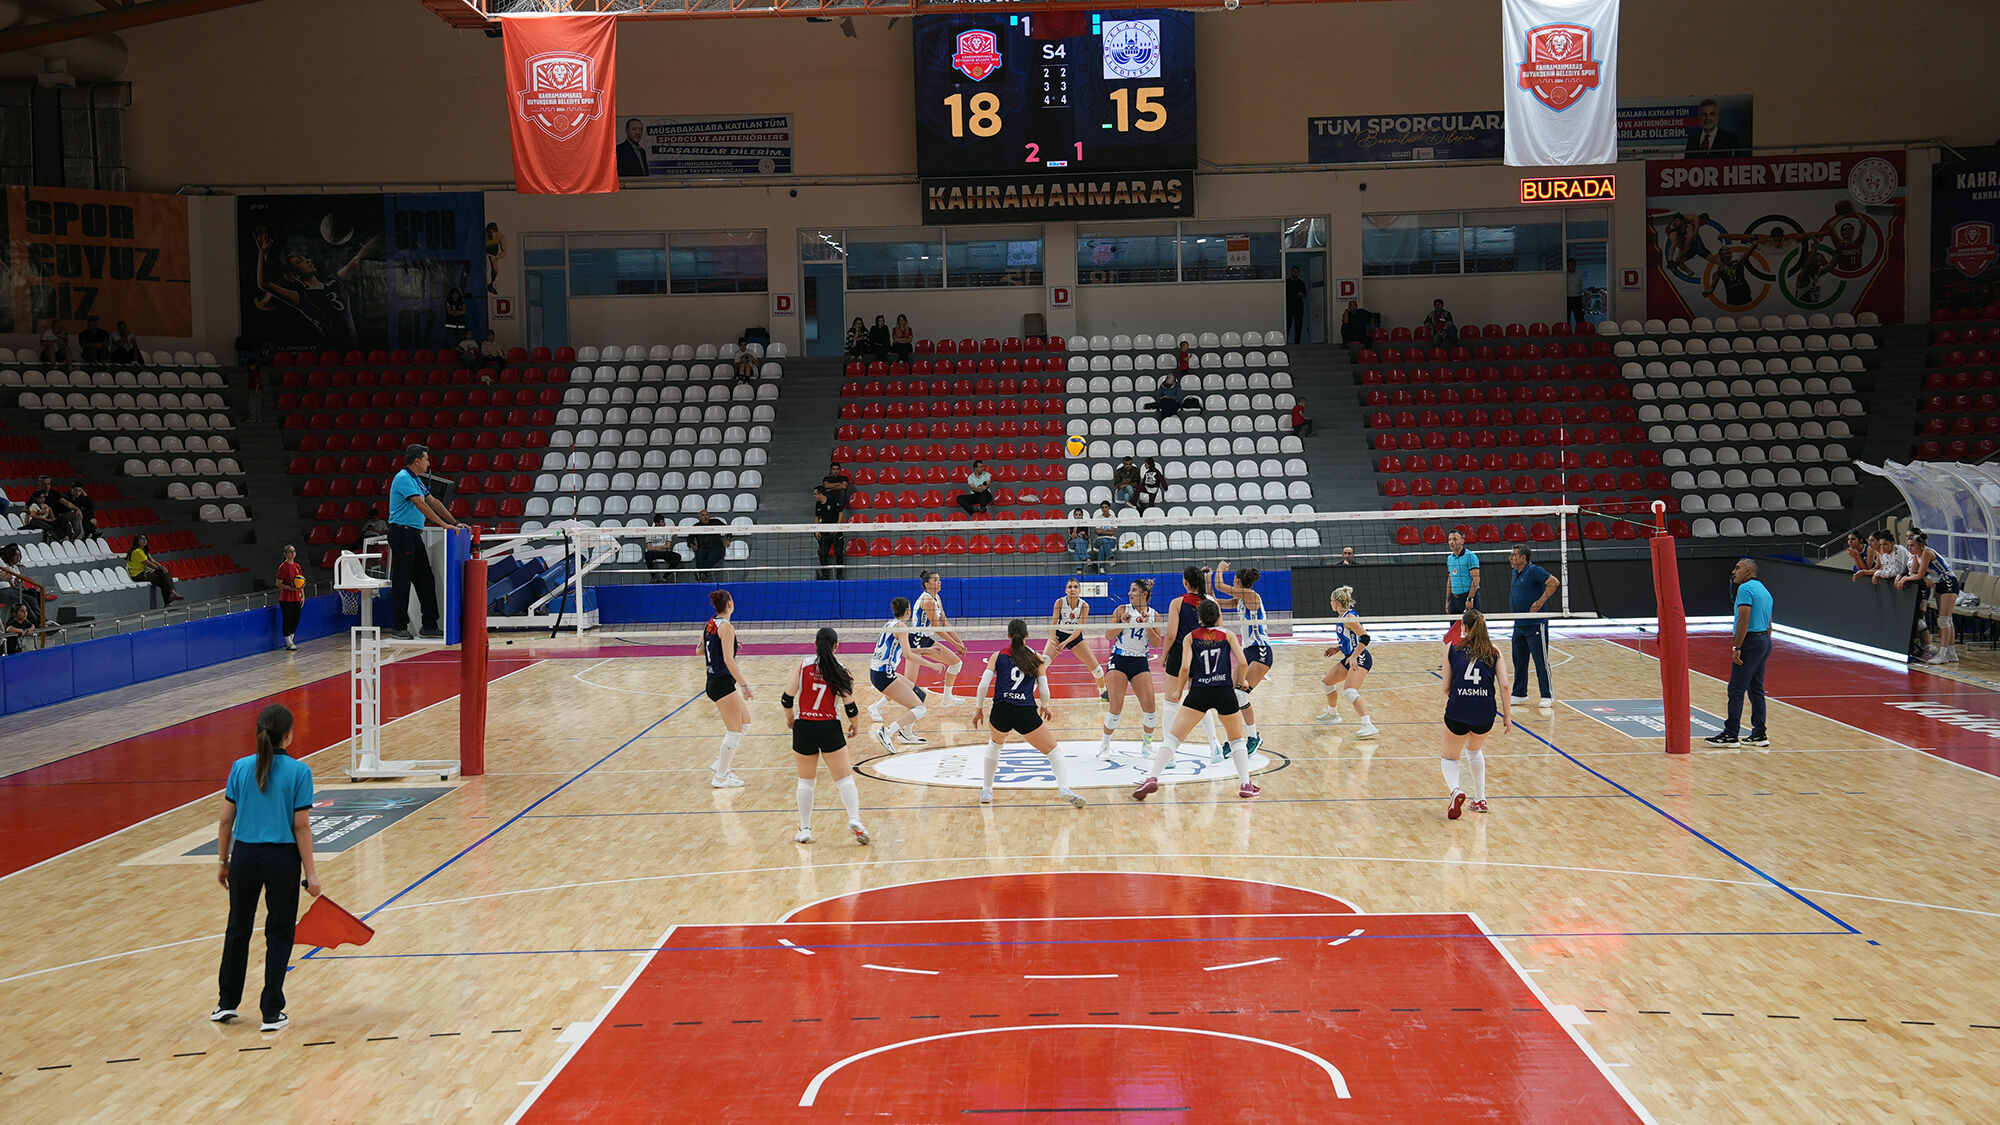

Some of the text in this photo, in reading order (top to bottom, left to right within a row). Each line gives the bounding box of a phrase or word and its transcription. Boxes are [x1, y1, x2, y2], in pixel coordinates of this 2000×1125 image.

[1042, 43, 1066, 60] S4
[1043, 67, 1067, 78] 2 2
[1043, 81, 1067, 92] 3 3
[1043, 94, 1067, 105] 4 4
[943, 91, 1003, 138] 18
[1109, 86, 1168, 132] 15
[1676, 107, 1689, 116] TÜM
[648, 118, 786, 135] MÜSABAKALARA KATILAN TÜM
[1314, 113, 1505, 136] TÜM SPORCULAR
[658, 135, 698, 144] SPORCU
[659, 146, 785, 157] BAŞARILAR DİLERİM.
[1025, 142, 1040, 163] 2
[1073, 141, 1083, 161] 1
[1660, 161, 1841, 189] SPOR HER YERDE
[1957, 170, 2000, 190] KAHR
[929, 179, 1183, 210] KAHRAMANMARAŞ
[1523, 179, 1615, 200] BURADA
[26, 200, 134, 239] SPOR
[395, 209, 457, 250] SPOR
[1624, 271, 1638, 285] D
[1055, 288, 1069, 303] D
[1341, 281, 1355, 296] D
[496, 299, 511, 315] D
[777, 296, 791, 311] D
[1130, 627, 1144, 640] 14
[1199, 648, 1221, 675] 17
[1010, 666, 1025, 691] 9
[1212, 673, 1227, 682] MİNE
[1463, 657, 1482, 685] 4
[812, 682, 827, 711] 7
[1003, 691, 1026, 700] ESRA
[1457, 687, 1488, 697] YASMİN
